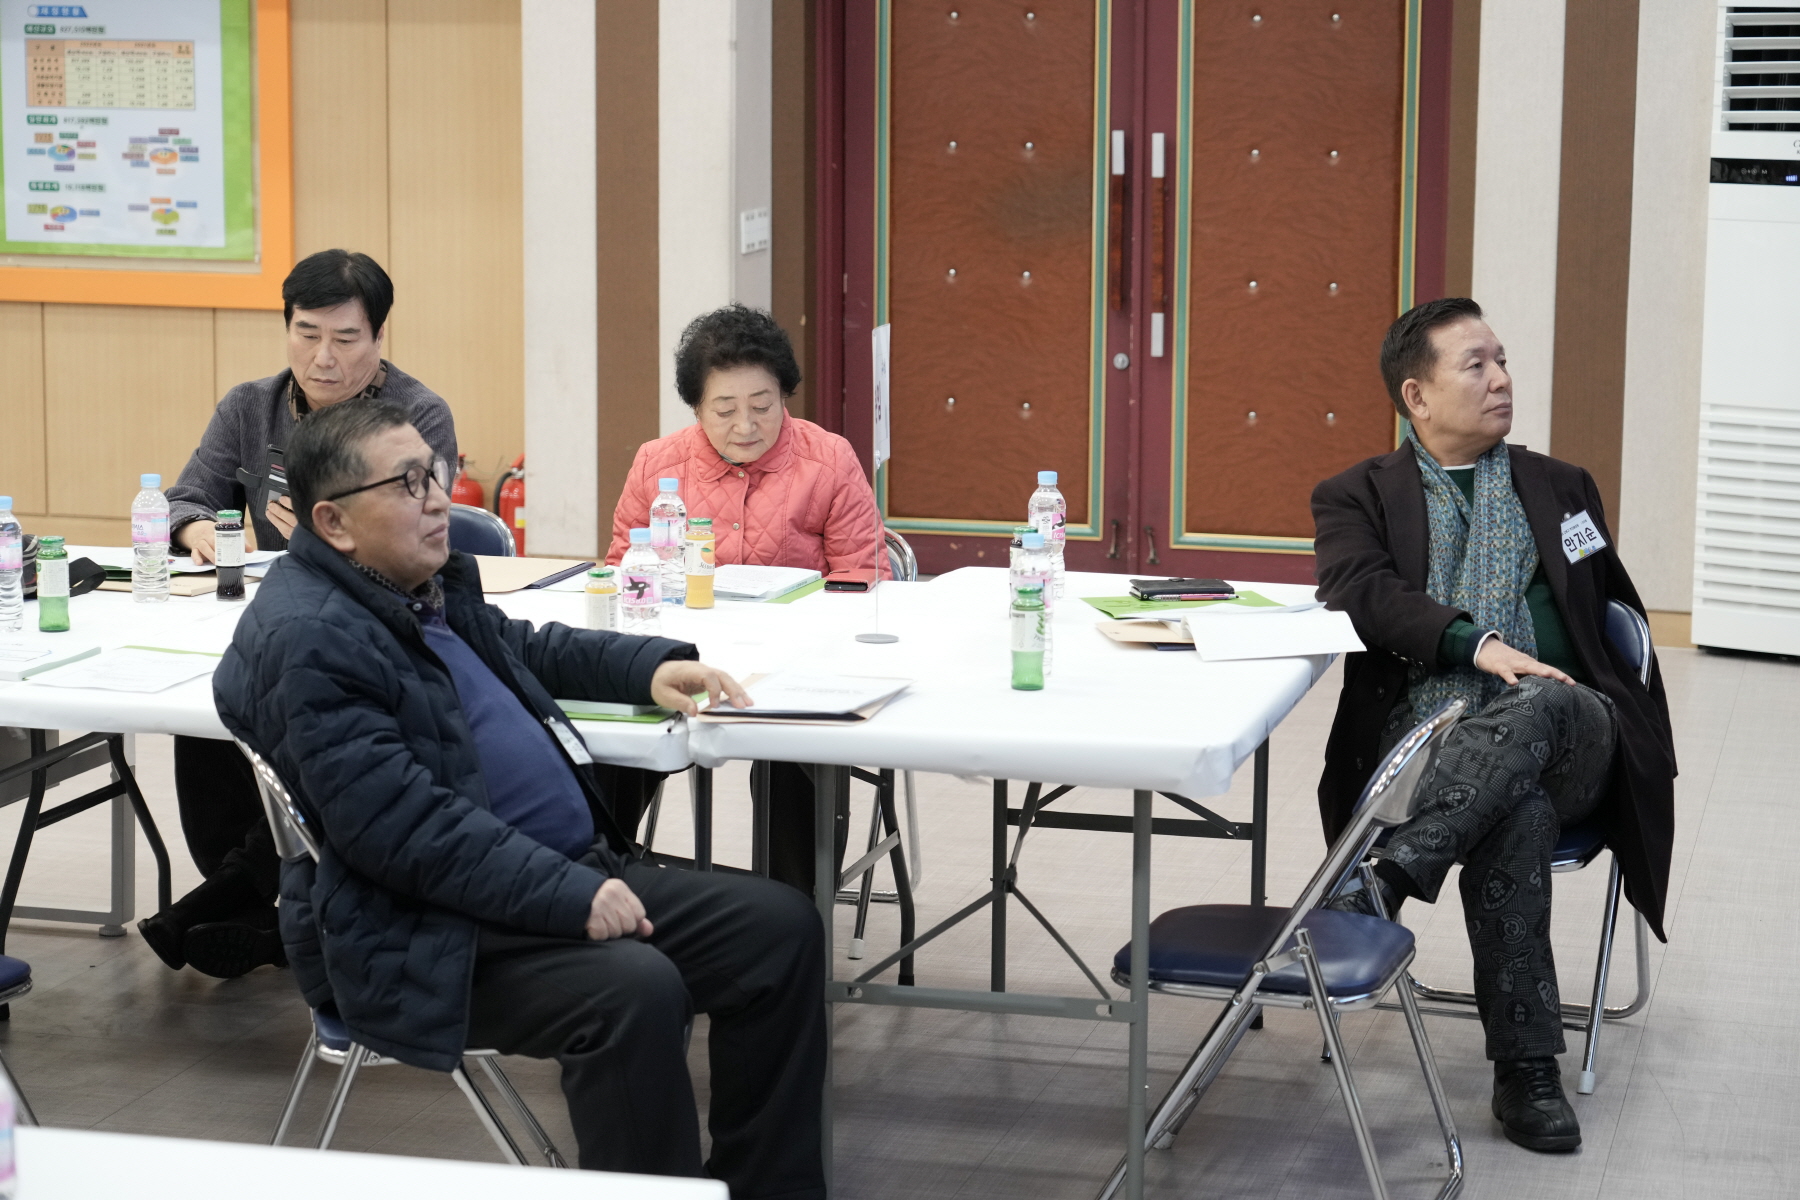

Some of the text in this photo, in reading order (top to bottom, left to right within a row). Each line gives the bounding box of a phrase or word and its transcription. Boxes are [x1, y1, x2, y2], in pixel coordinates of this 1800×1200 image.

[1564, 527, 1598, 553] 안지순
[1494, 724, 1509, 743] 45
[1514, 1003, 1525, 1023] 45
